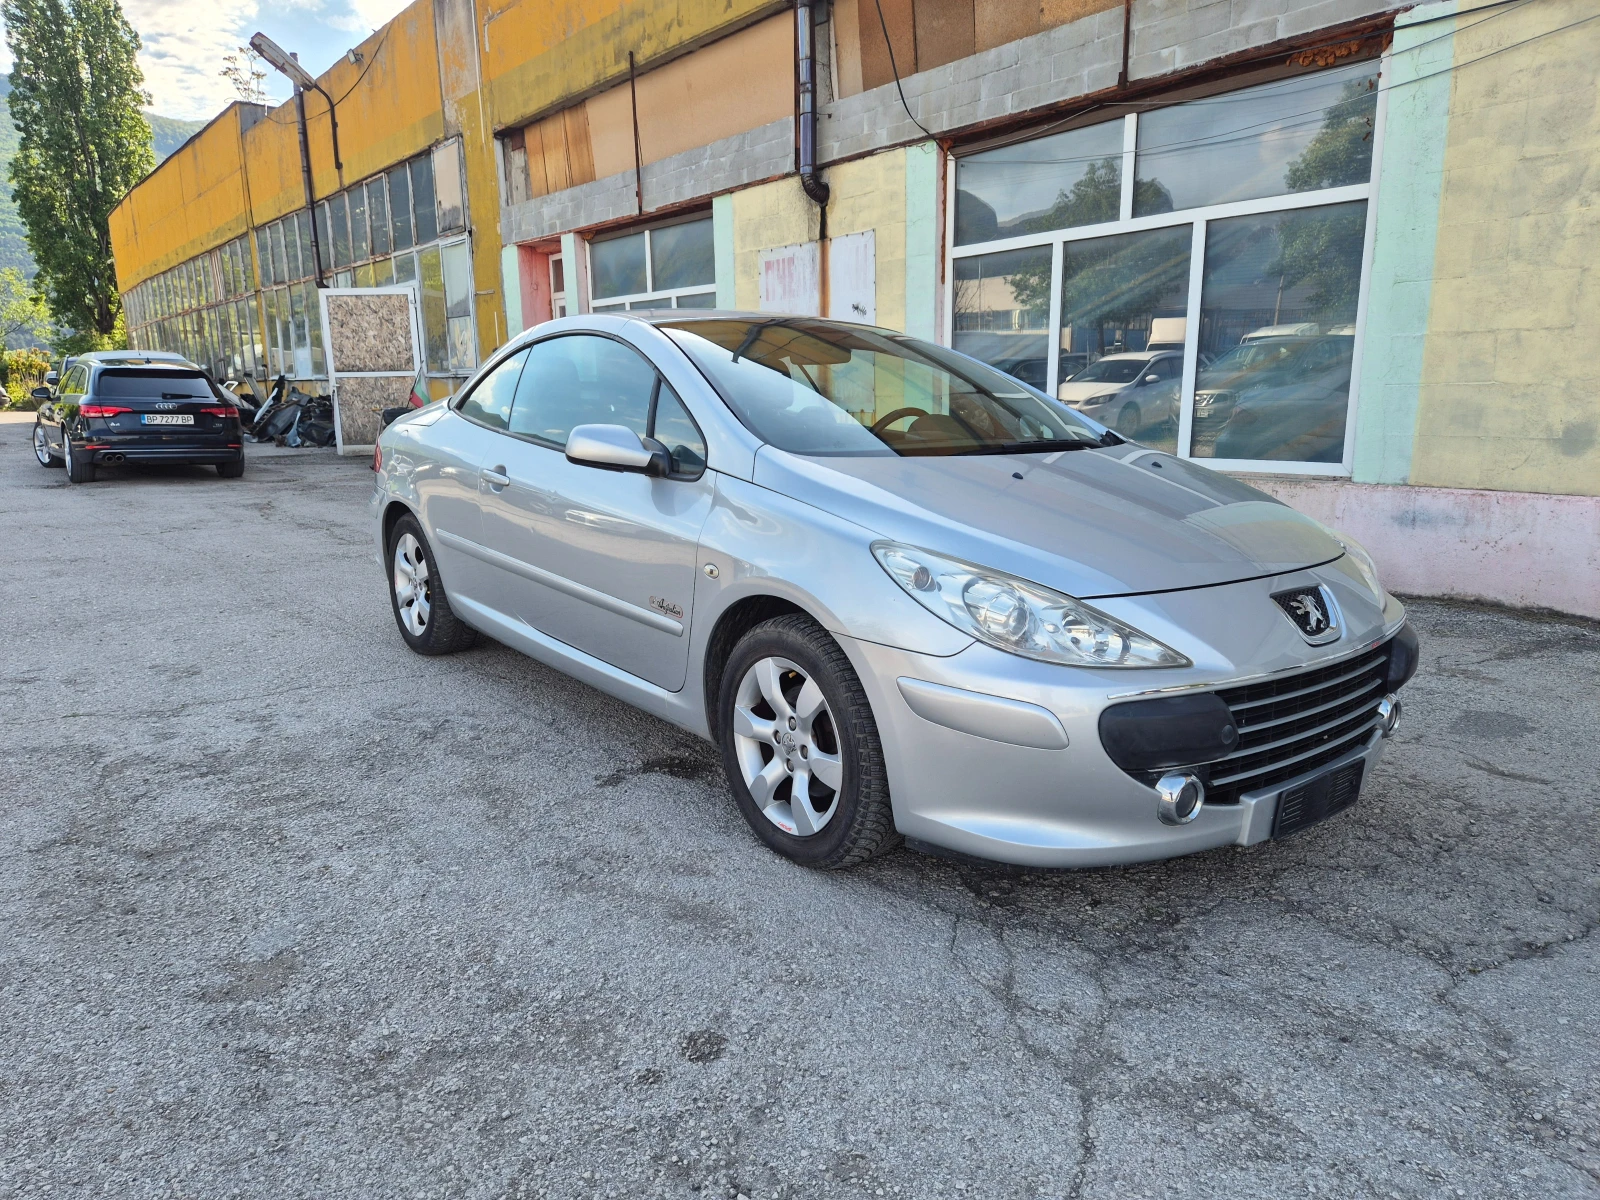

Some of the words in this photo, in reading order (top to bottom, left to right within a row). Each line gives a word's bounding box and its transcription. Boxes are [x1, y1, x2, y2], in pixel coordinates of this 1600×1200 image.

[146, 415, 158, 424] BP
[159, 415, 180, 424] 7277
[181, 415, 193, 424] BP
